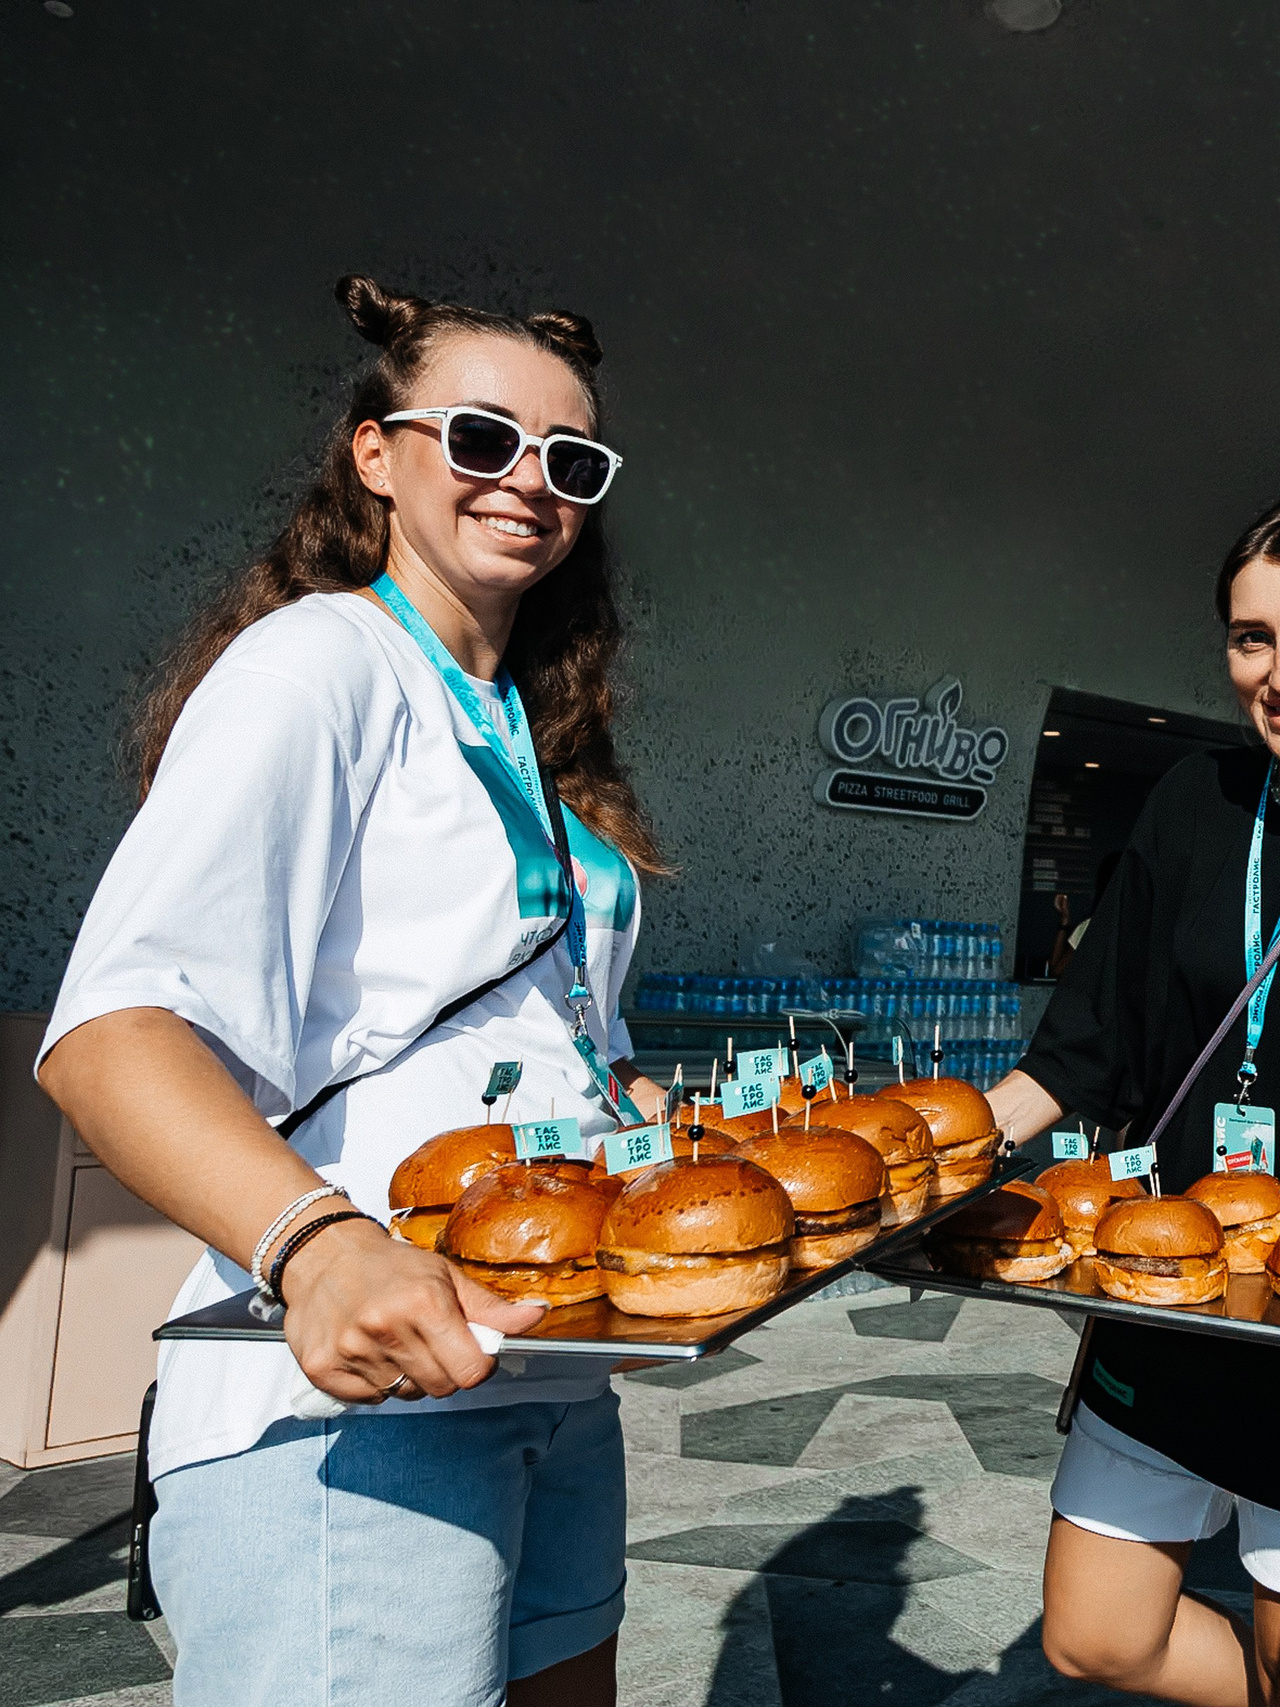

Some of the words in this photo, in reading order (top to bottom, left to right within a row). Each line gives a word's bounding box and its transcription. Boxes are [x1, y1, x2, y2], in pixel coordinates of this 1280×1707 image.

[837, 782, 868, 796] PIZZA
[874, 786, 938, 804] STREETFOOD
[943, 794, 970, 808] GRILL
[754, 1054, 772, 1062] ГАС
[741, 1083, 763, 1094] ГАС
[742, 1091, 764, 1101] ТРО
[742, 1100, 764, 1110] ЛИС
[535, 1126, 558, 1134] ГАС
[536, 1134, 560, 1142] ТРО
[627, 1134, 650, 1147] ГАС
[538, 1142, 561, 1151] ЛИС
[627, 1143, 651, 1155] ТРО
[628, 1152, 652, 1164] ЛИС
[1124, 1154, 1140, 1162] ГАС
